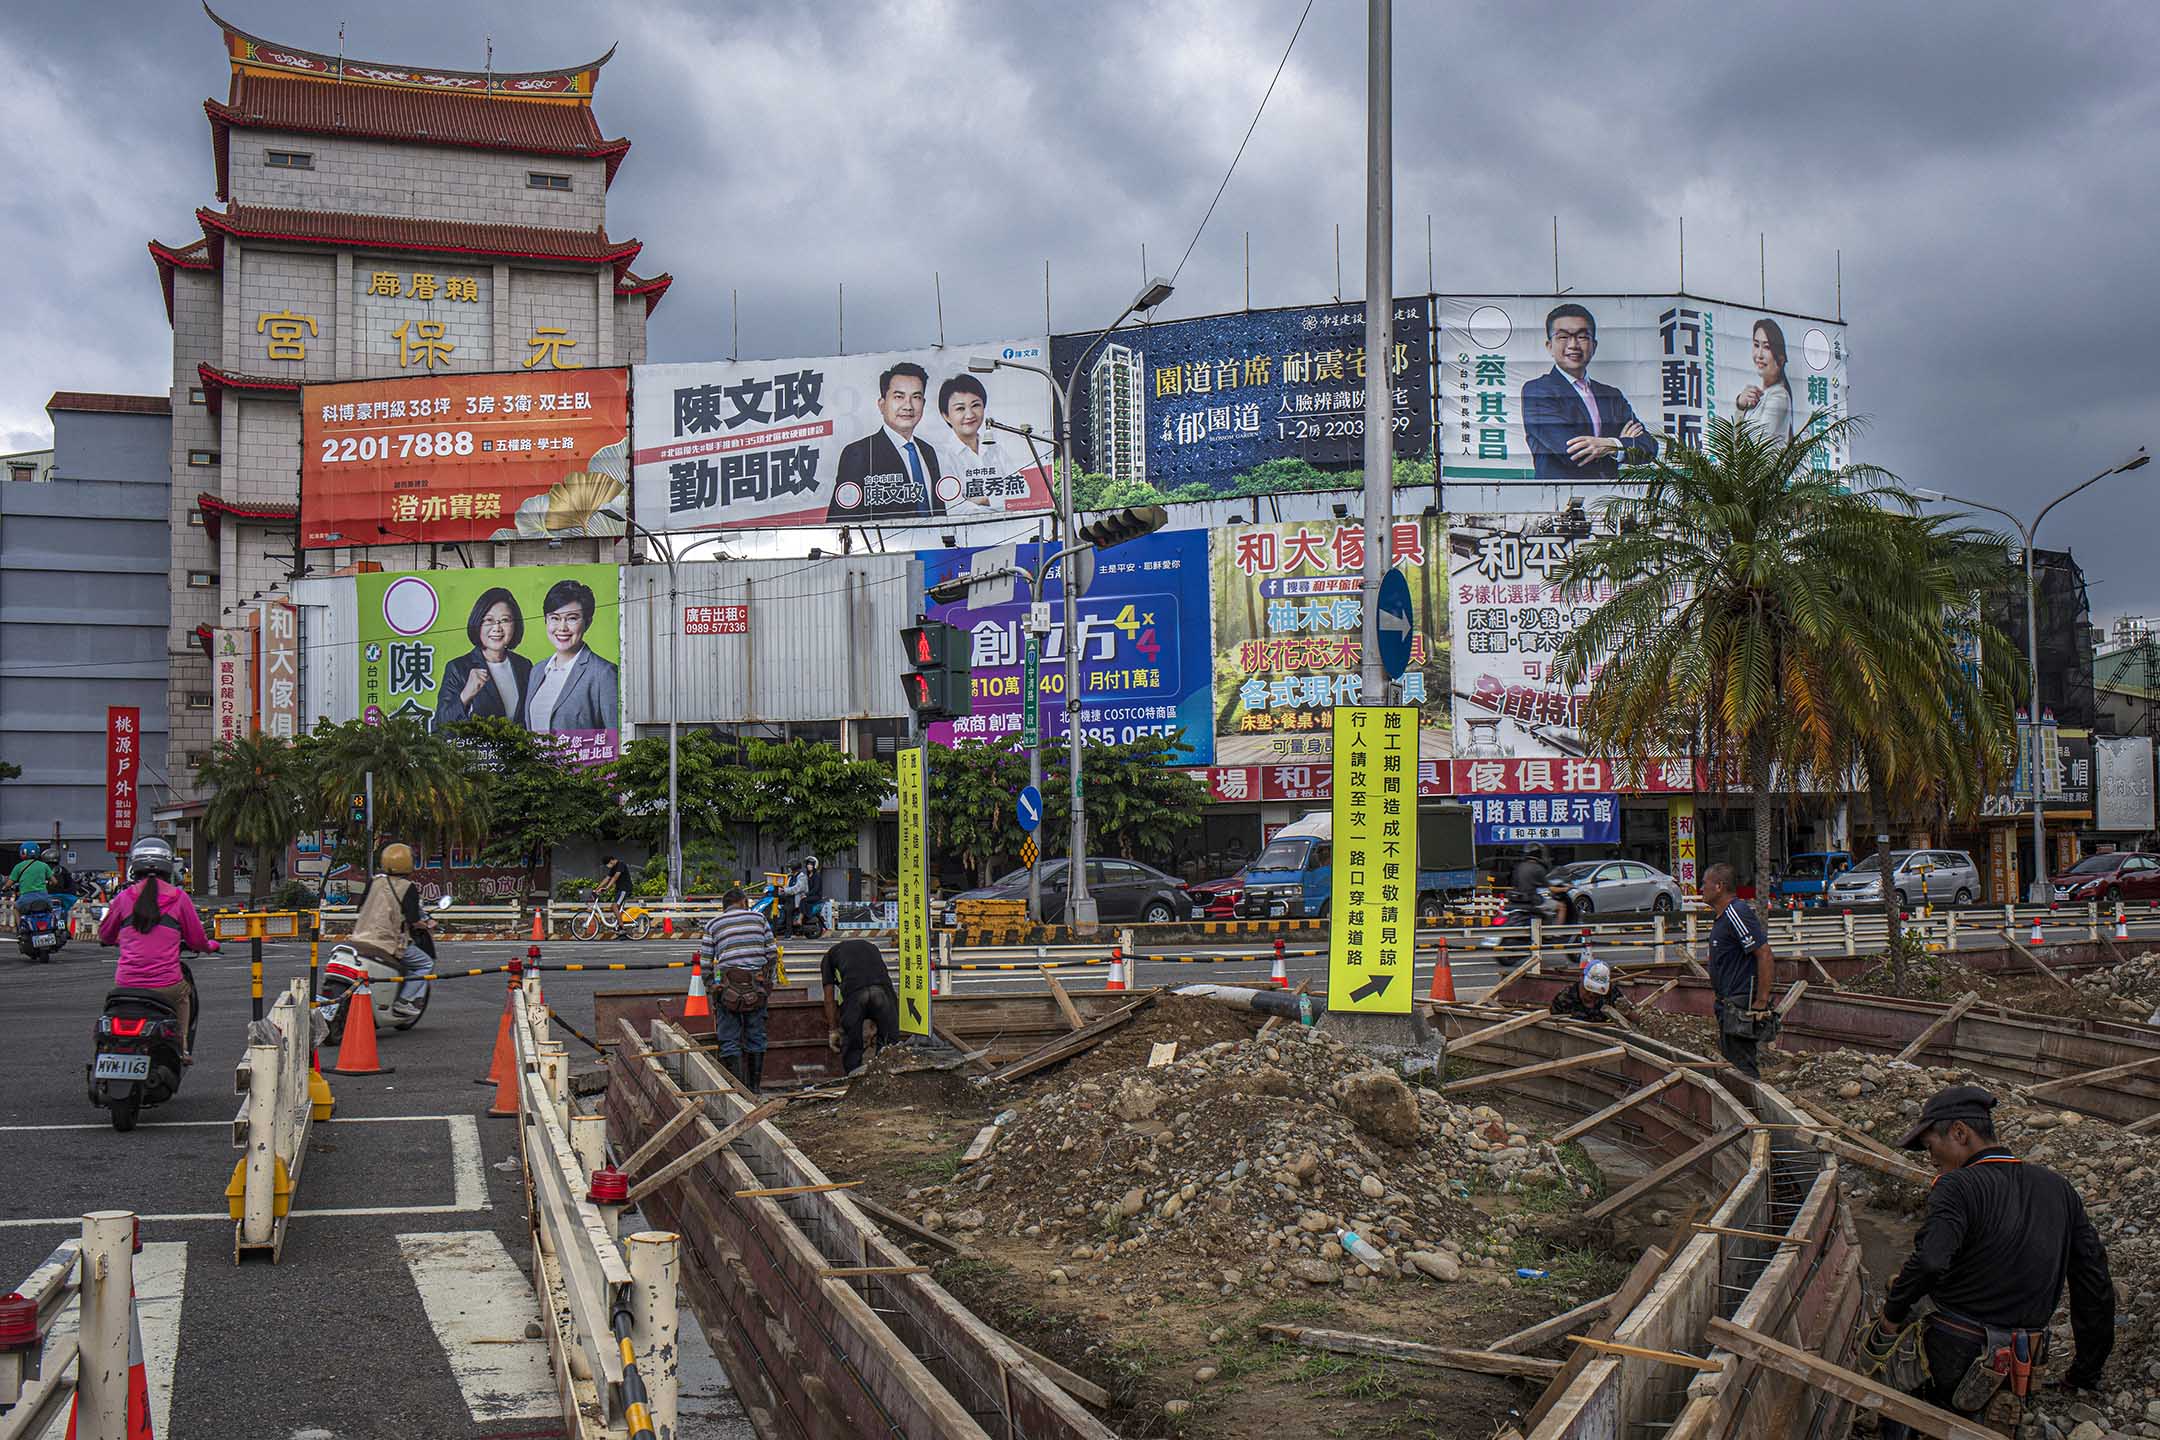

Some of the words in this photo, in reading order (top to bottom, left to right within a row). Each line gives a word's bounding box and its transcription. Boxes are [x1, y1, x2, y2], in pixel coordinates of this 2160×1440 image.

[1703, 311, 1717, 396] TAICHUNG
[1156, 353, 1272, 398] 園道首席
[322, 398, 451, 423] 科博豪門級38坪
[674, 368, 823, 437] 陳文政
[1277, 387, 1409, 415] 人臉辨識防宅
[1460, 369, 1471, 456] 台中市長候選人
[1475, 354, 1508, 460] 蔡其昌
[1175, 402, 1260, 445] 郁園道
[1325, 416, 1410, 437] 220399
[322, 431, 474, 463] 2201-7888
[668, 445, 821, 514] 勤問政
[864, 473, 904, 485] 台中市議員
[965, 467, 997, 477] 台中市長
[965, 474, 1026, 498] 盧秀燕
[391, 492, 502, 524] 澄亦實築
[864, 482, 925, 507] 陳文政
[1287, 580, 1311, 594] 搜尋
[1459, 584, 1541, 606] 多樣化選擇
[686, 622, 746, 634] 0989-577336
[687, 606, 738, 623] 廣告出租
[1267, 600, 1364, 634] 柚木傢
[970, 612, 1117, 668] 創立方
[1239, 635, 1427, 673] 桃花芯木
[270, 608, 294, 746] 和大傢俱
[367, 665, 378, 704] 台中市
[1239, 671, 1427, 710] 各式現代俱
[953, 715, 986, 733] 微商
[1060, 709, 1101, 723] 北機捷
[1104, 705, 1177, 721] COSTCO特商區
[115, 715, 134, 797] 桃源戶外
[1467, 758, 1693, 793] 傢俱拍場
[1470, 798, 1612, 824] 網路實體展示館
[1346, 711, 1368, 967] 行人請改至次一路口穿越道路
[1379, 712, 1402, 967] 施工期間造成不便敬請見諒
[1515, 827, 1561, 839] 和平傢俱
